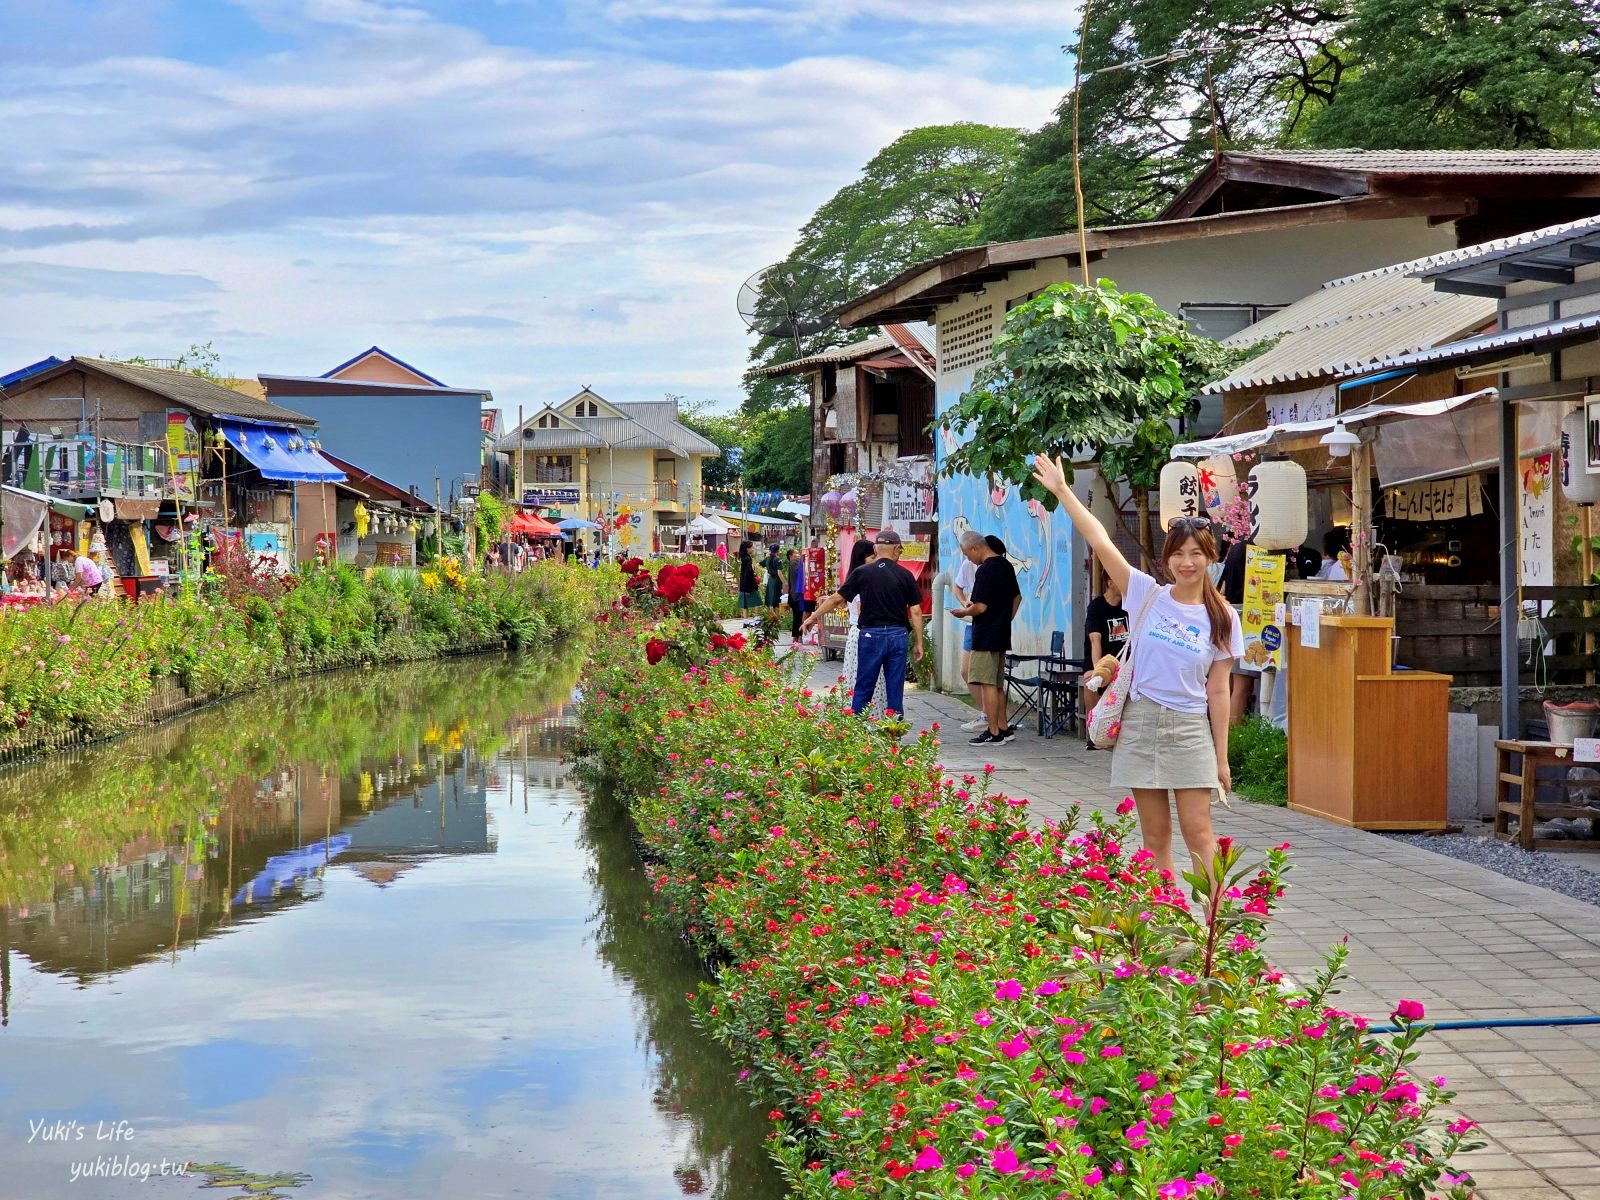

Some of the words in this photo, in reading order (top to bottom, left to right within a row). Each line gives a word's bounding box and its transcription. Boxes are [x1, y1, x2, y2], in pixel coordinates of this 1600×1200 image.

[1179, 474, 1198, 517] 餃子
[1398, 486, 1455, 515] こんにちは
[1148, 630, 1171, 645] SNOOPY
[1172, 638, 1185, 648] AND
